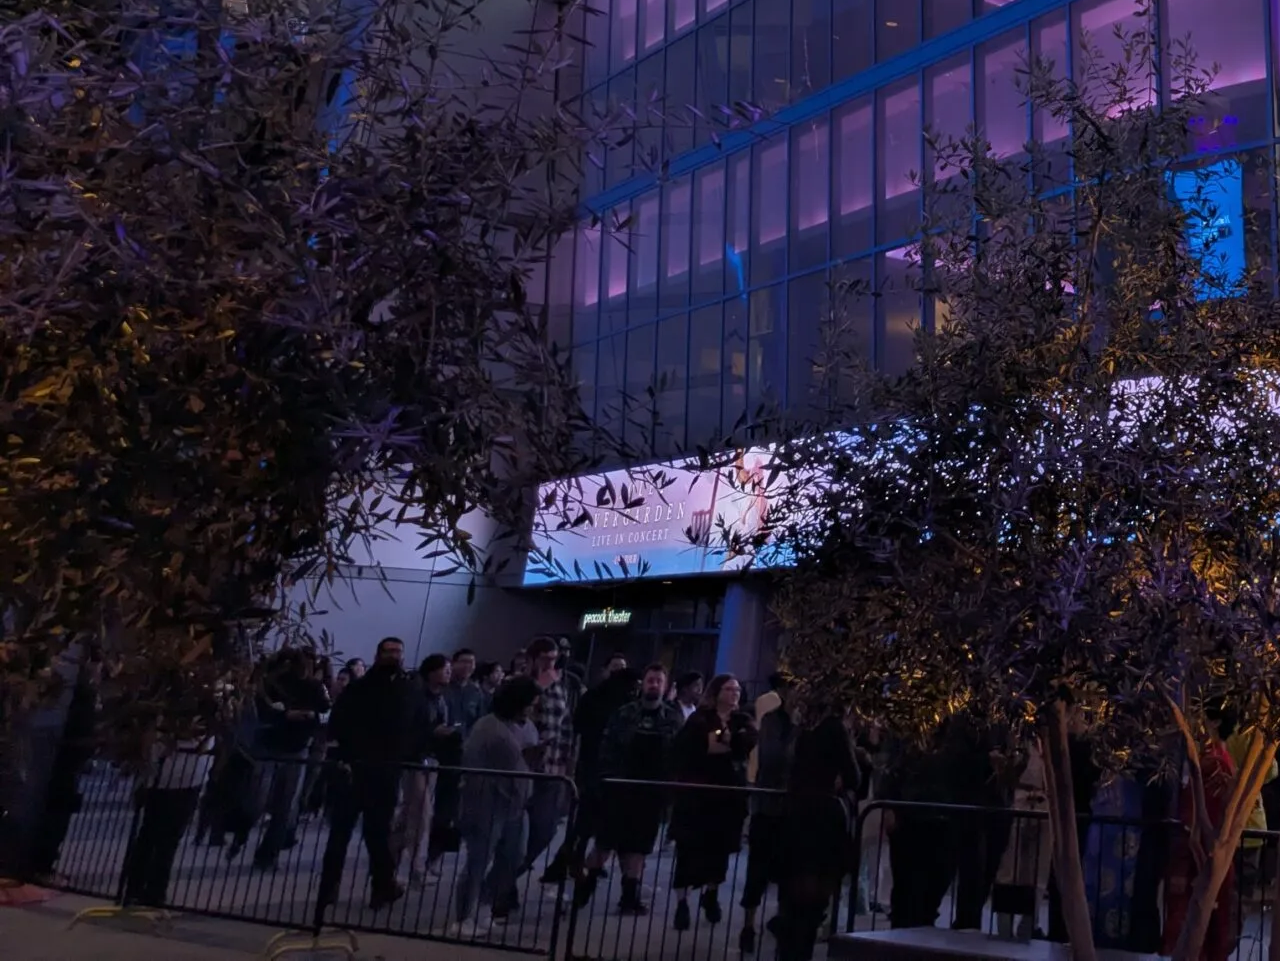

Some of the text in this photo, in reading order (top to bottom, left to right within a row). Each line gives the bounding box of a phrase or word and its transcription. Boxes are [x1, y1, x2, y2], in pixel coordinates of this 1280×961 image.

[592, 534, 612, 547] LIVE
[628, 528, 669, 543] CONCERT
[582, 609, 632, 630] peacock theater
